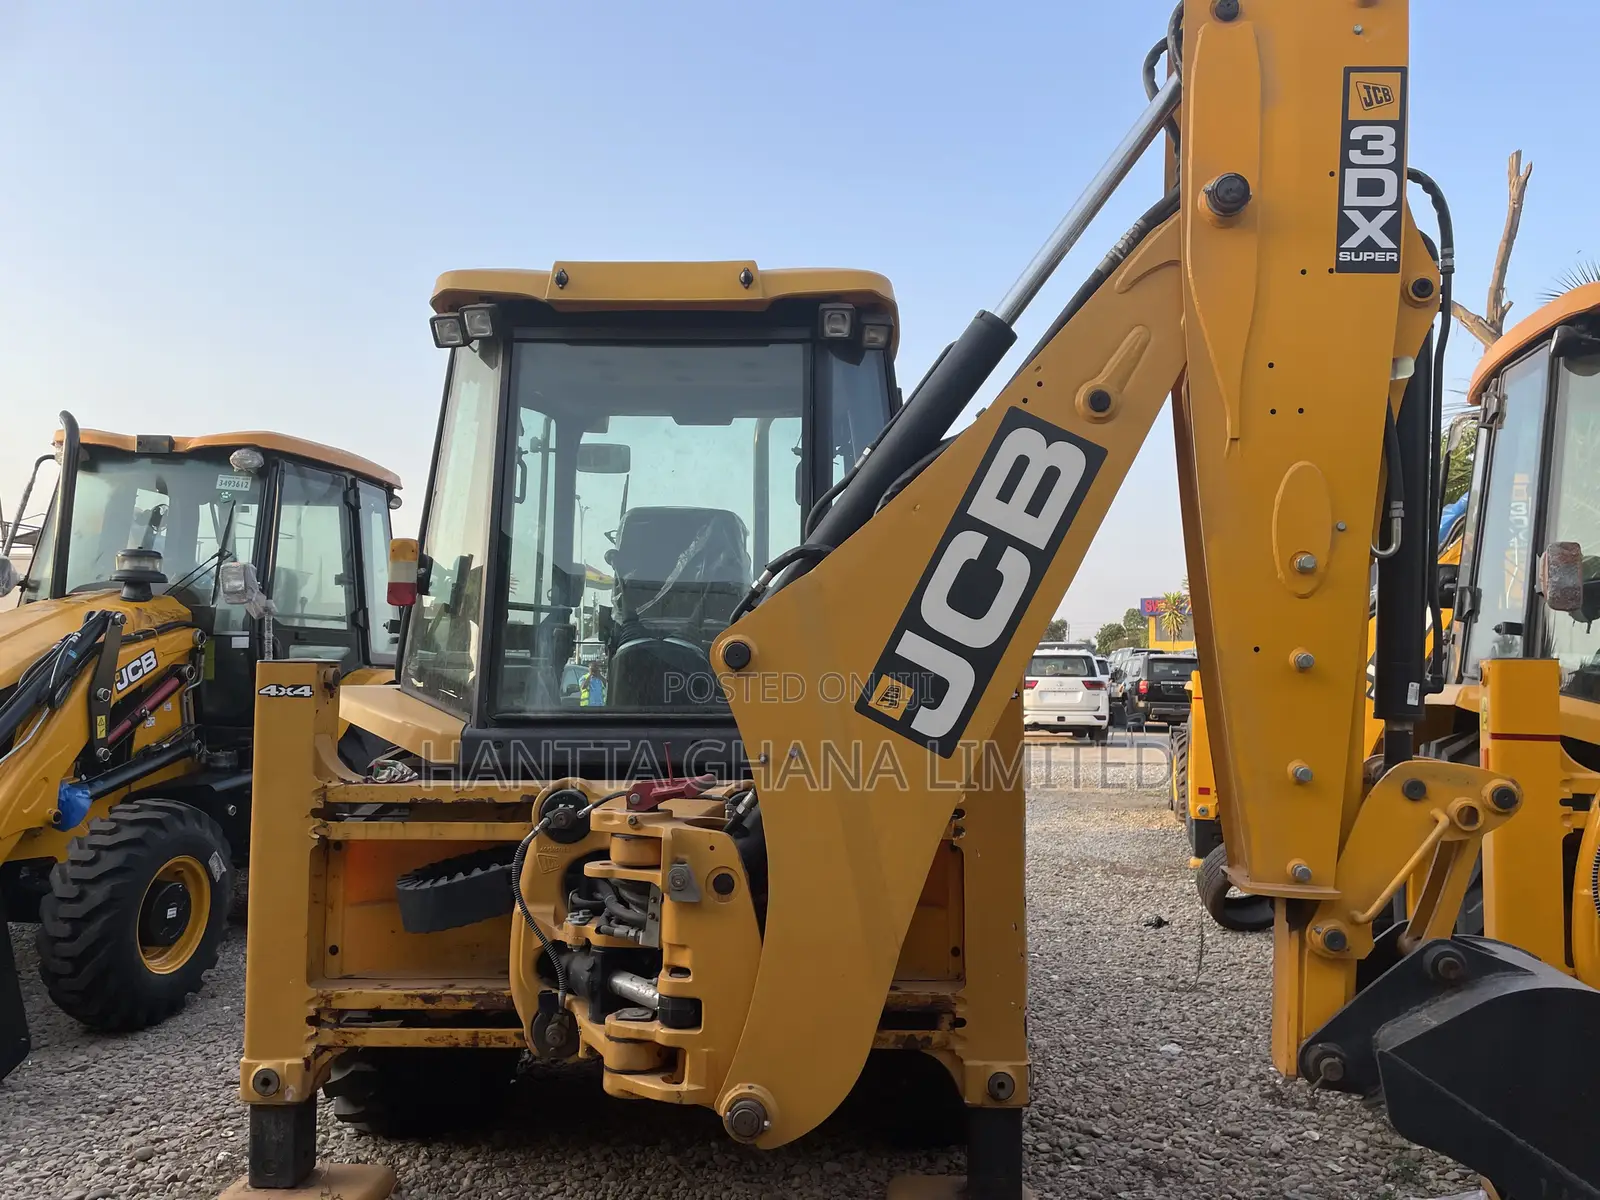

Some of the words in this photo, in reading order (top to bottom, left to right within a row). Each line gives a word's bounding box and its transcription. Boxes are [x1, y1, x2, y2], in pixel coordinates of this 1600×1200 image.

[1363, 84, 1391, 108] JCB
[1338, 251, 1398, 262] SUPER
[219, 480, 249, 488] 3493612
[895, 427, 1087, 738] JCB
[116, 650, 157, 690] JCB
[880, 686, 900, 706] JCB
